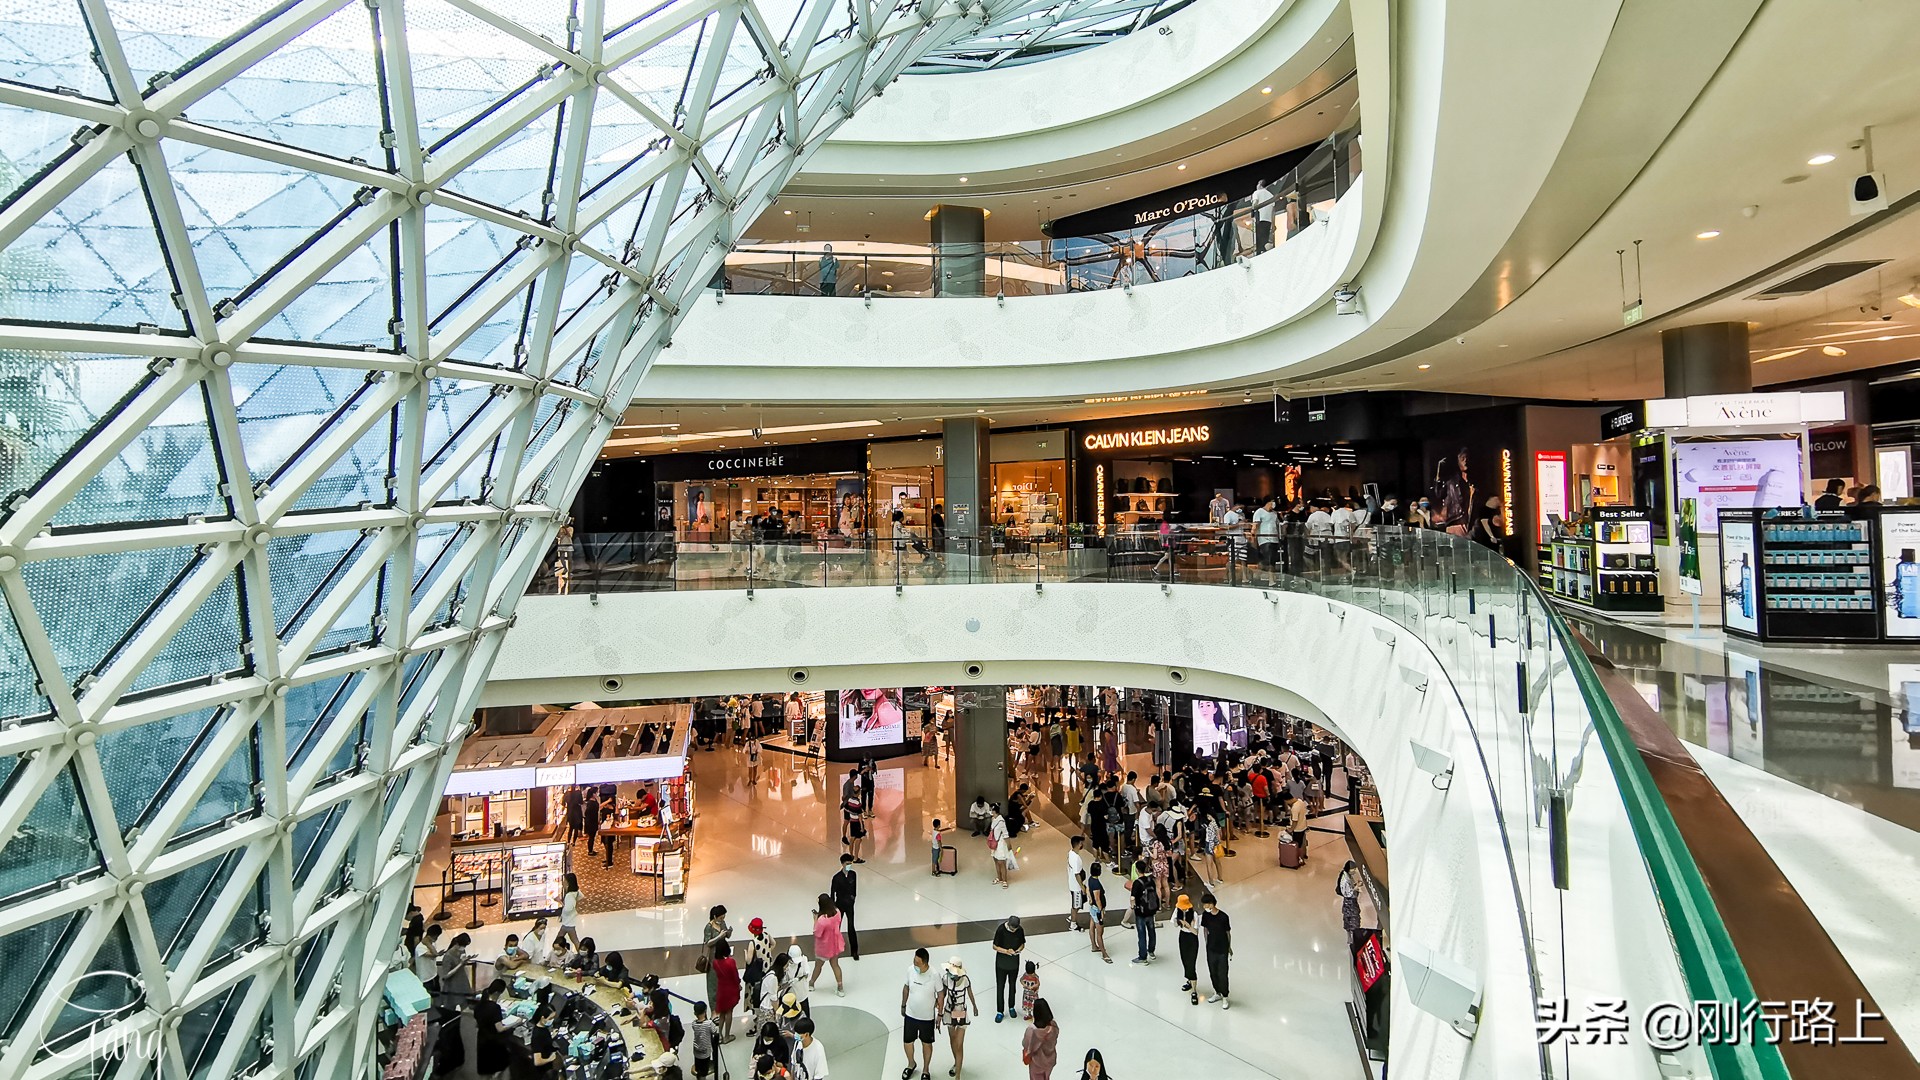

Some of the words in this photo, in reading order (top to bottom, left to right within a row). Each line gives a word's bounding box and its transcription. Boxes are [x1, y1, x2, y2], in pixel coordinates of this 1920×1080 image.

[1134, 207, 1171, 225] Marc
[1717, 406, 1772, 419] Avène
[1084, 432, 1129, 450] CALVIN
[1130, 429, 1166, 447] KLEIN
[1166, 426, 1209, 445] JEANS
[708, 455, 784, 470] COCCINELLE
[1502, 448, 1512, 483] CALVIN
[1096, 464, 1105, 493] CALVIN
[1097, 493, 1105, 514] KLEIN
[1503, 482, 1513, 507] KLEIN
[1504, 506, 1514, 537] JEANS
[1599, 510, 1619, 518] Best
[1620, 510, 1645, 518] Seller
[539, 768, 572, 783] fresh
